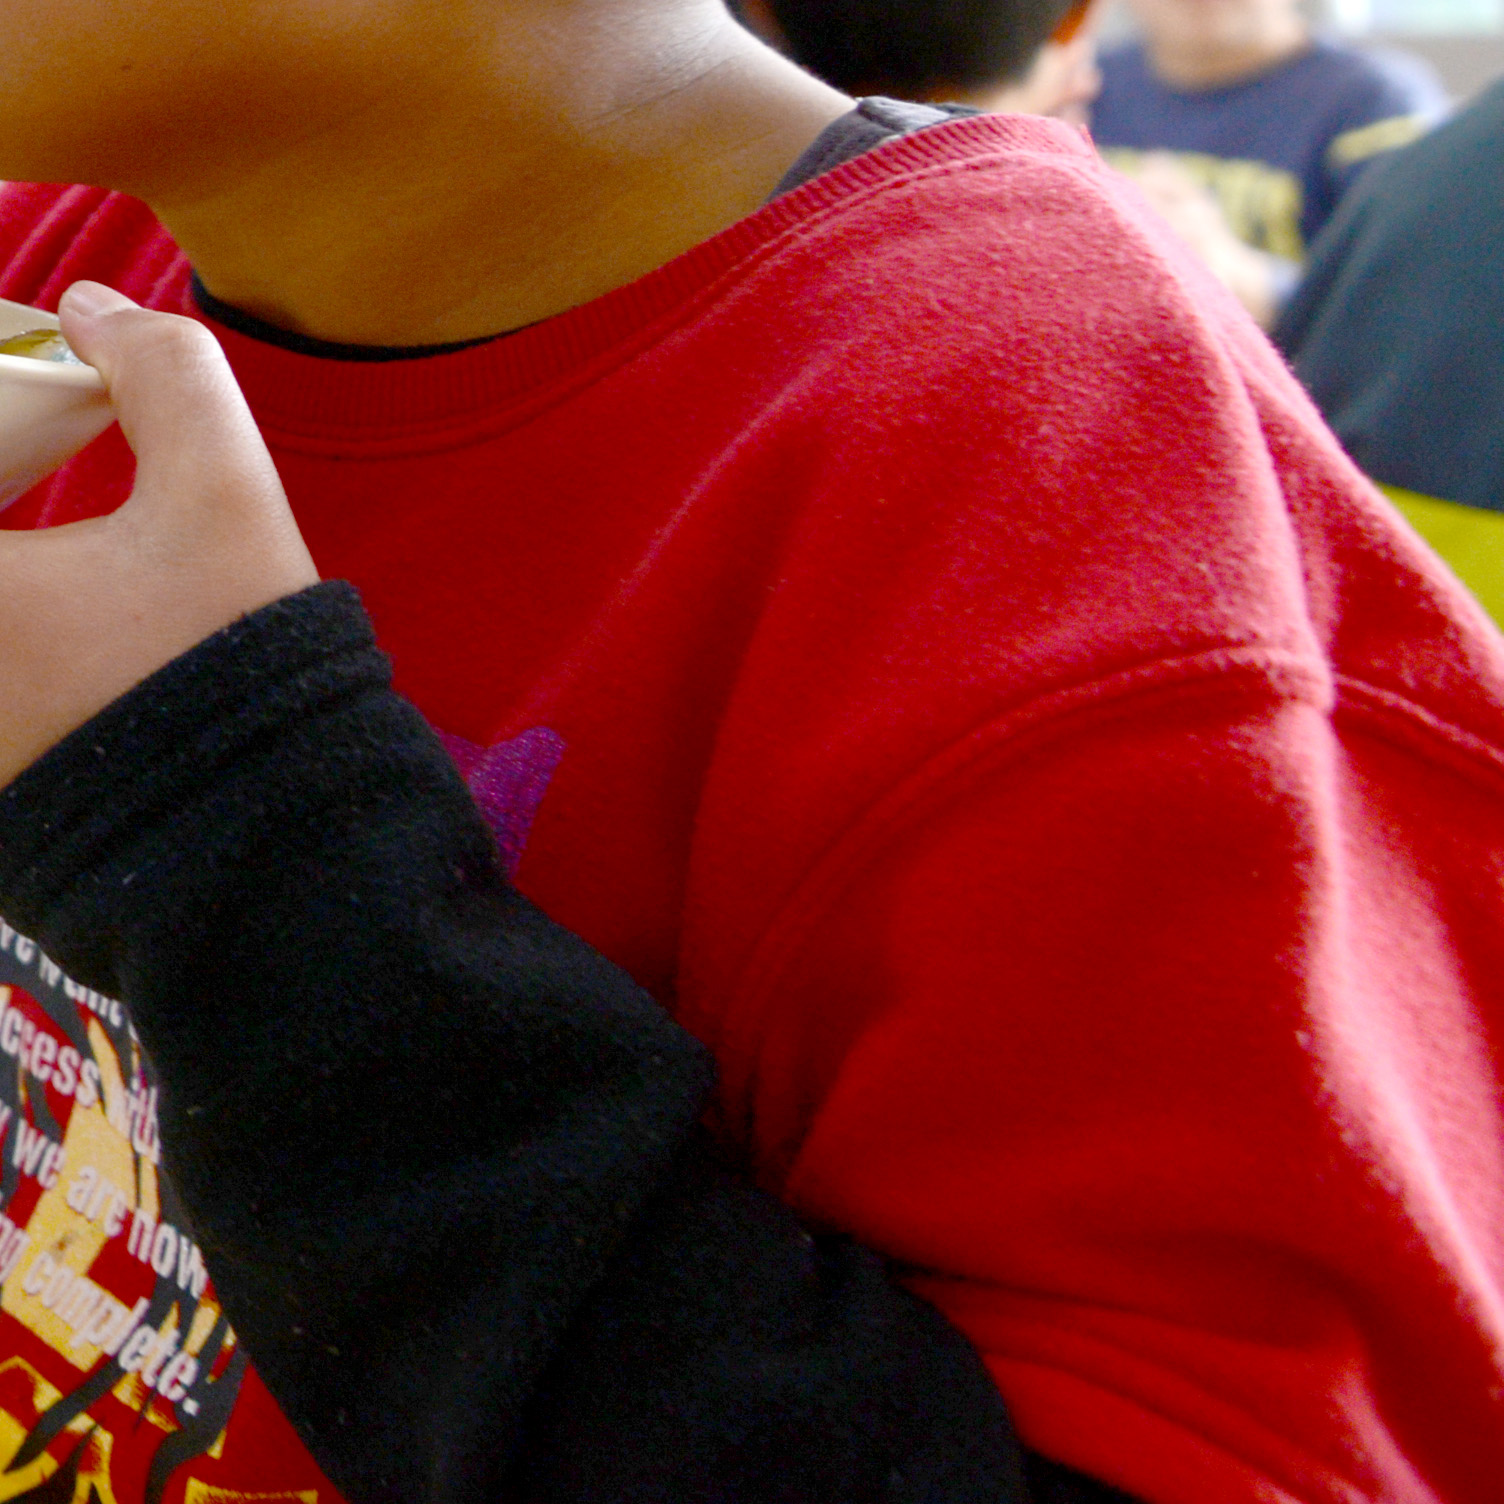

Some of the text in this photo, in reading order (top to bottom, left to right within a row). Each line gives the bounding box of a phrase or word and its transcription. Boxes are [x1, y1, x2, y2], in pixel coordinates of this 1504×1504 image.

[12, 1118, 66, 1191] we
[65, 1164, 130, 1238] are
[127, 1206, 210, 1300] now
[20, 1252, 201, 1416] complete.
